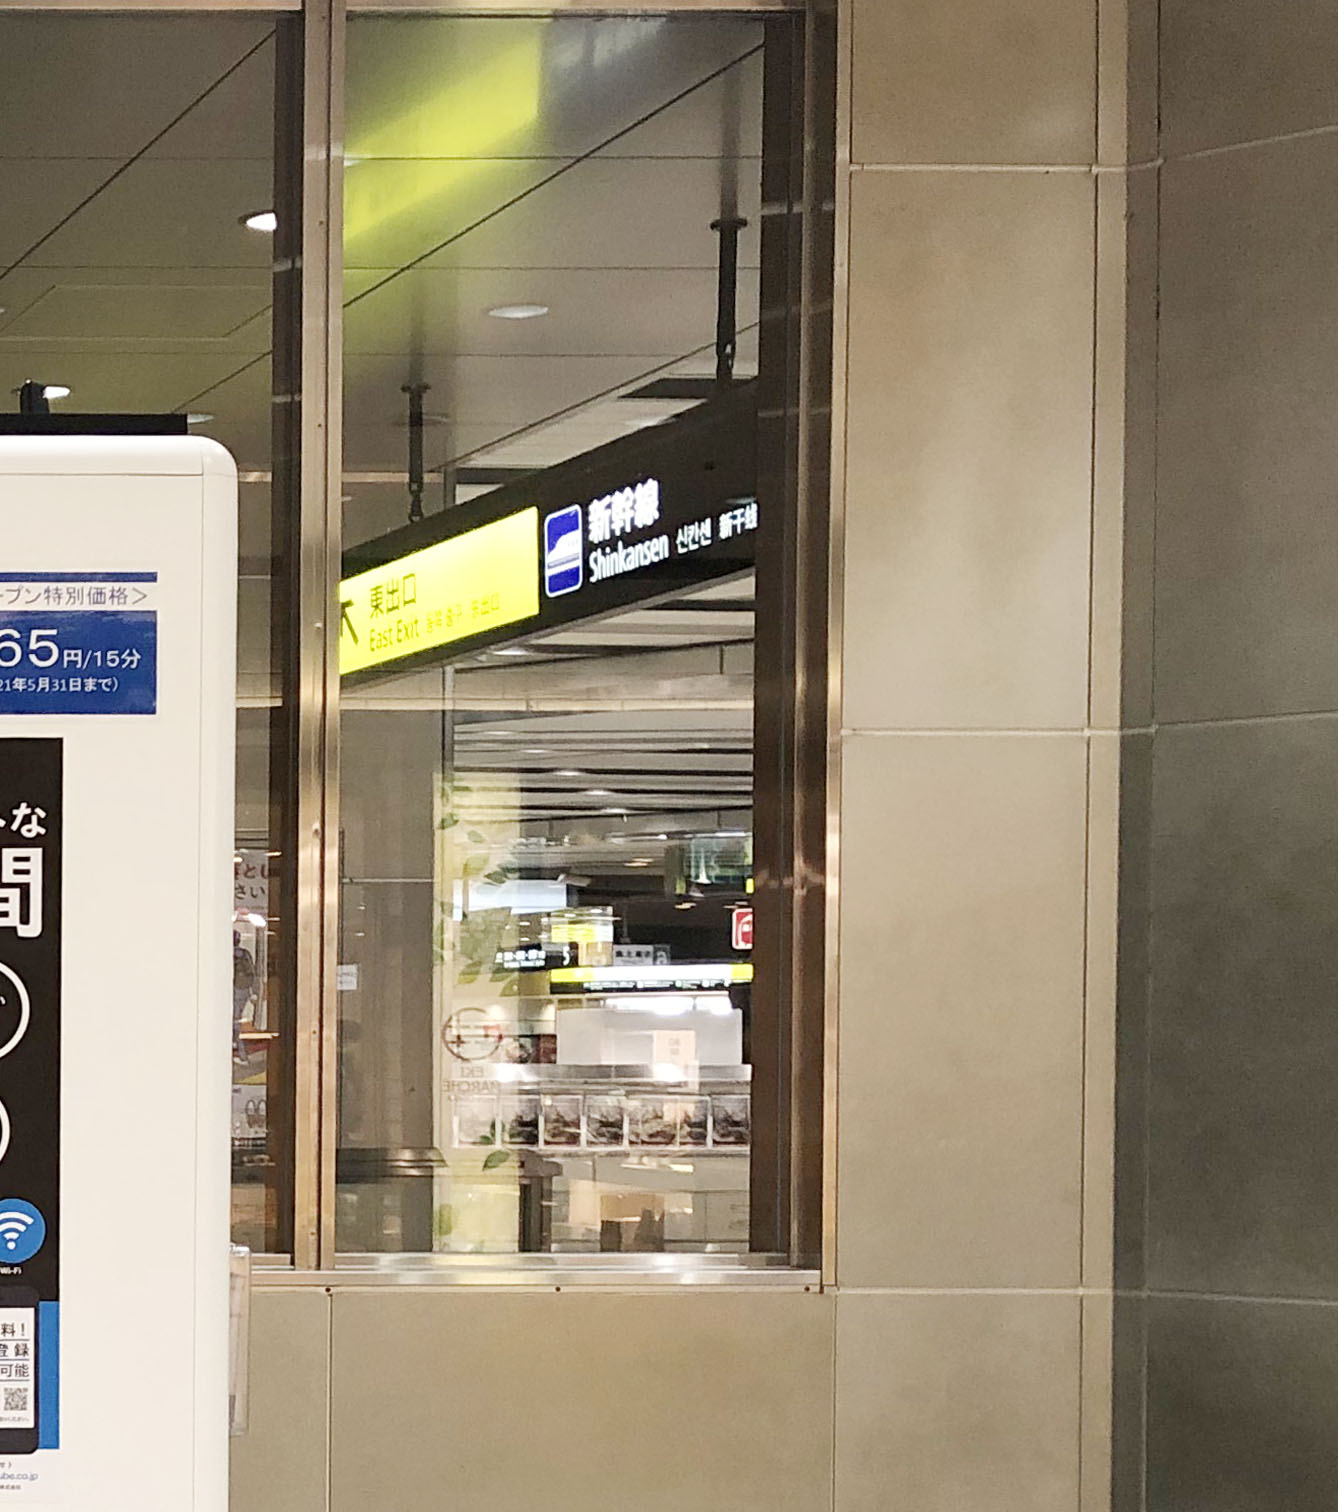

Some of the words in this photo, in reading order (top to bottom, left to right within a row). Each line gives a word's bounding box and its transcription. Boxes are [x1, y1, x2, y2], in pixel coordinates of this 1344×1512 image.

[588, 477, 660, 544] 新幹線
[588, 534, 670, 583] Shinkansen
[369, 573, 417, 619] 東出口
[369, 627, 394, 652] East
[396, 618, 420, 643] Exit
[0, 1266, 22, 1275] Wi-Fi
